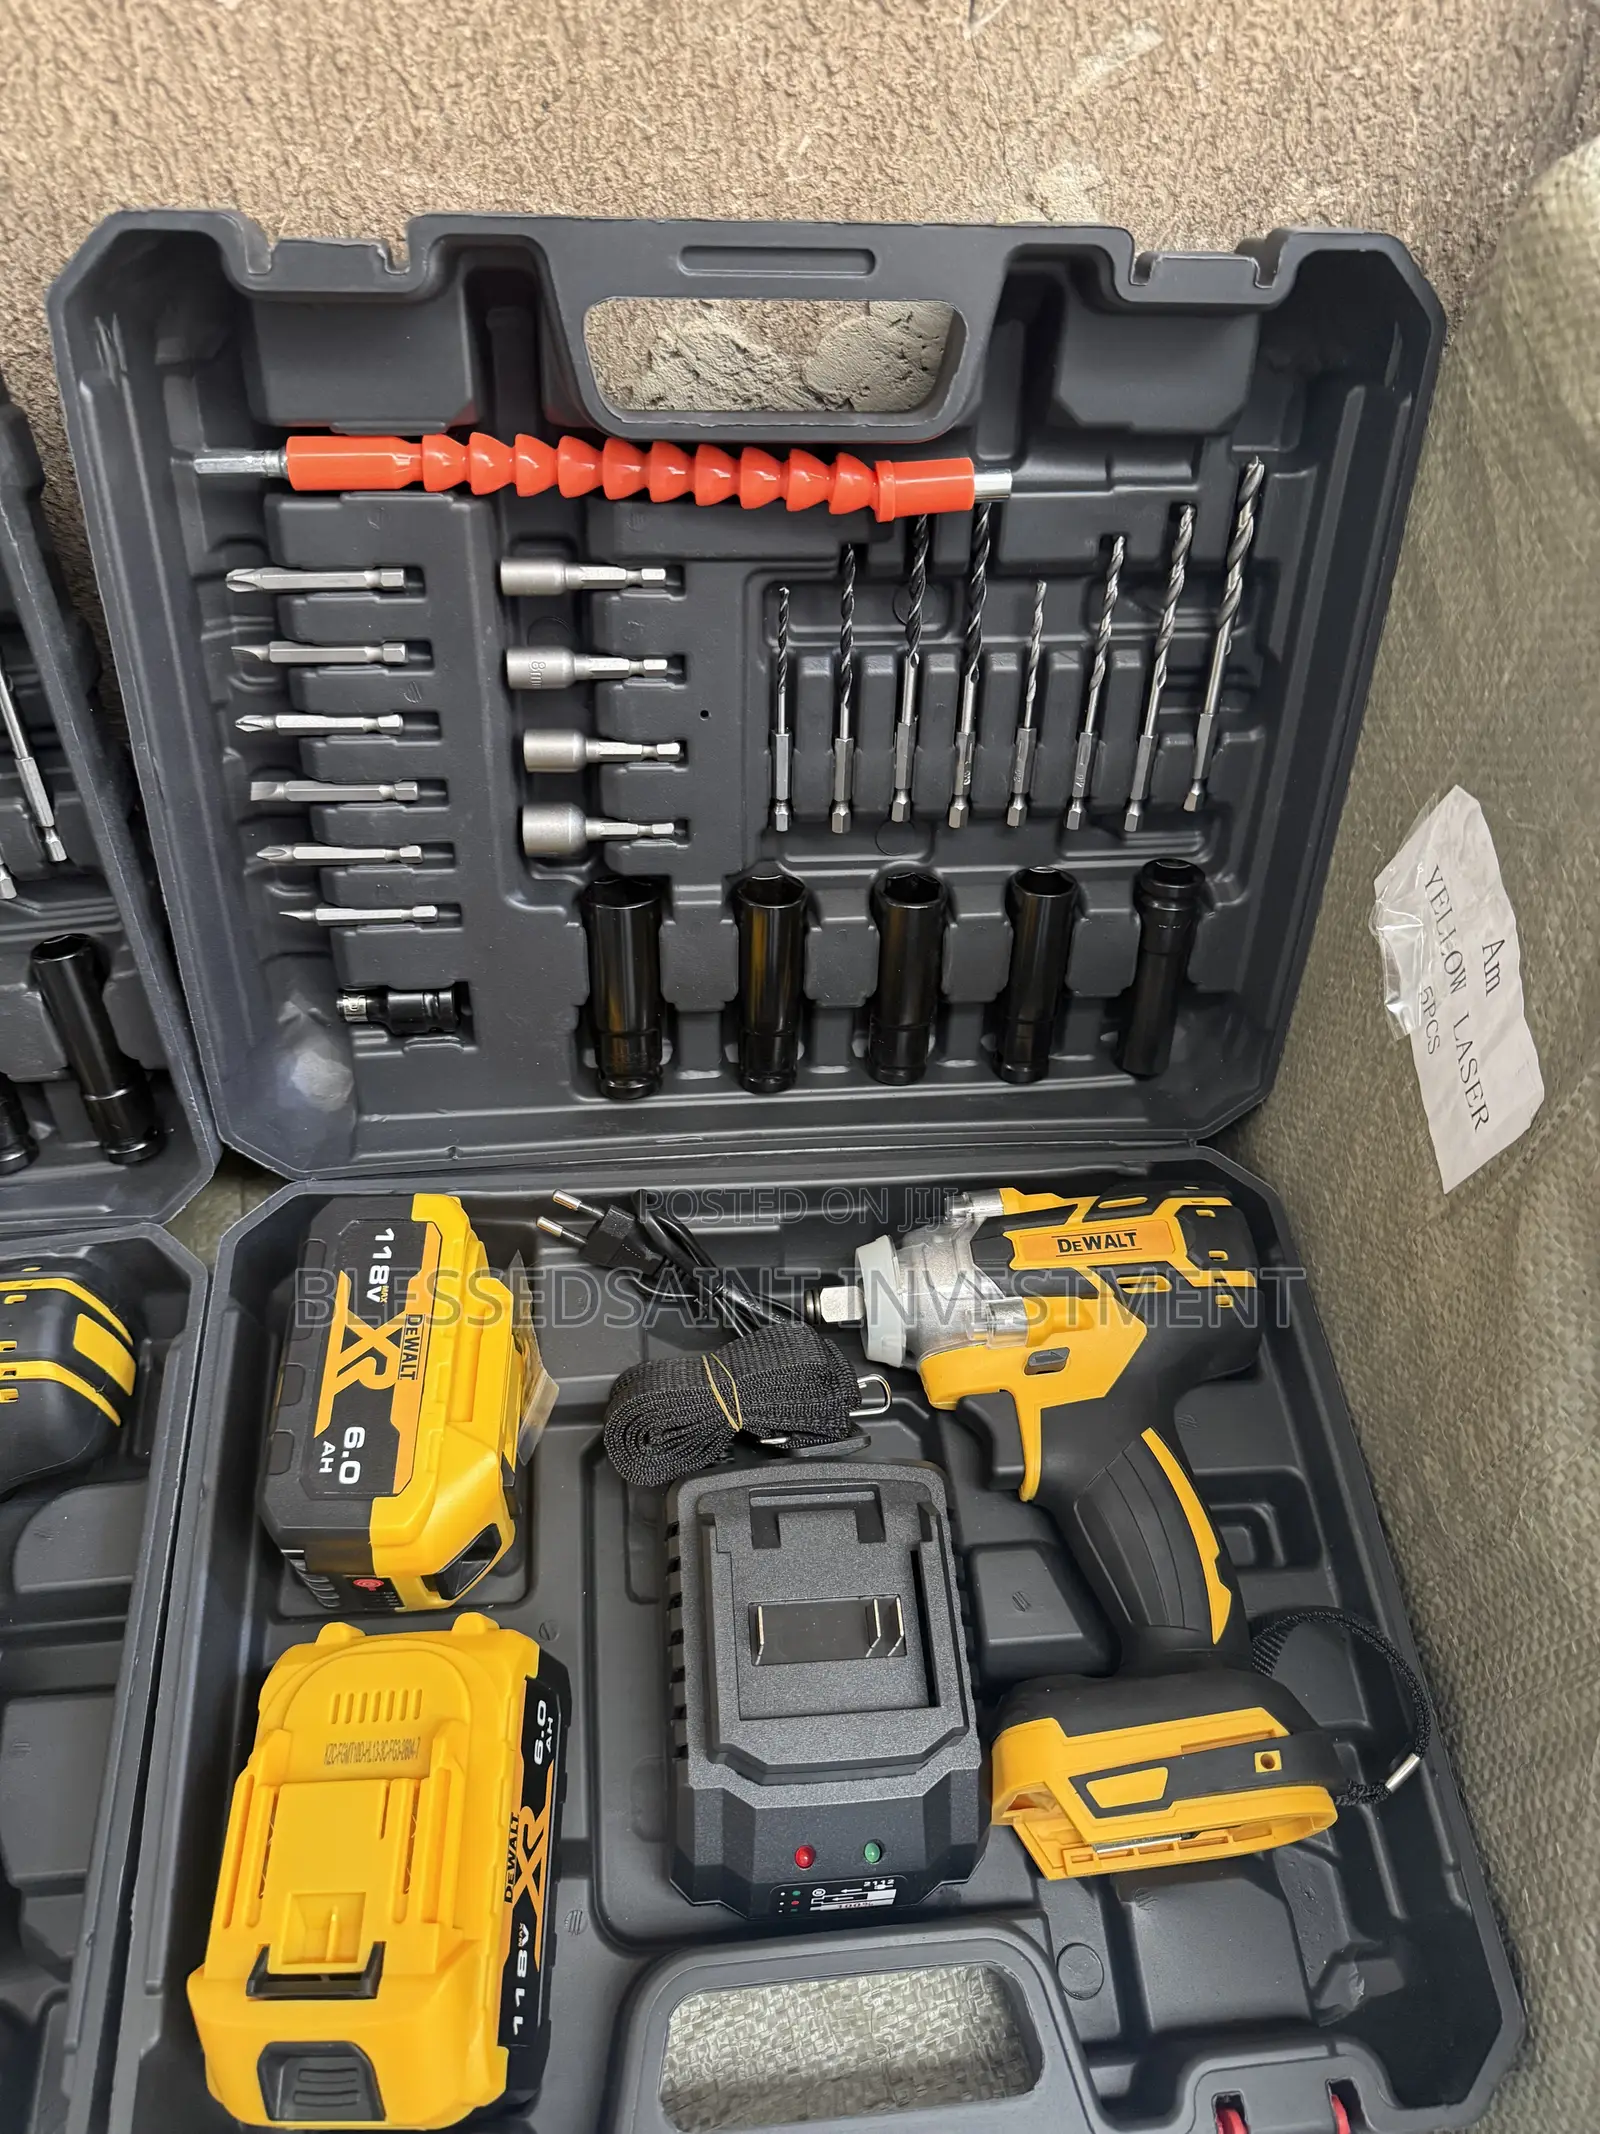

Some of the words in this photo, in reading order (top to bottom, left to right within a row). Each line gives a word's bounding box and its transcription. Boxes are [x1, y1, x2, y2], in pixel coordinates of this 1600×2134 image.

[1425, 864, 1467, 995] YELLOW
[1453, 1011, 1490, 1133] LASER
[1482, 938, 1506, 997] Am
[1421, 985, 1441, 1056] 5PCS
[367, 1227, 395, 1303] 118V
[1057, 1231, 1137, 1255] DEWALT
[380, 1285, 389, 1304] MAX
[314, 1269, 404, 1439] XR
[399, 1314, 424, 1381] DEWALT
[318, 1440, 336, 1474] AH
[339, 1426, 366, 1485] 6.0
[534, 1699, 546, 1766] 6.0
[545, 1717, 554, 1753] AH
[503, 1812, 519, 1905] DEWALT
[512, 1924, 530, 2036] 118V
